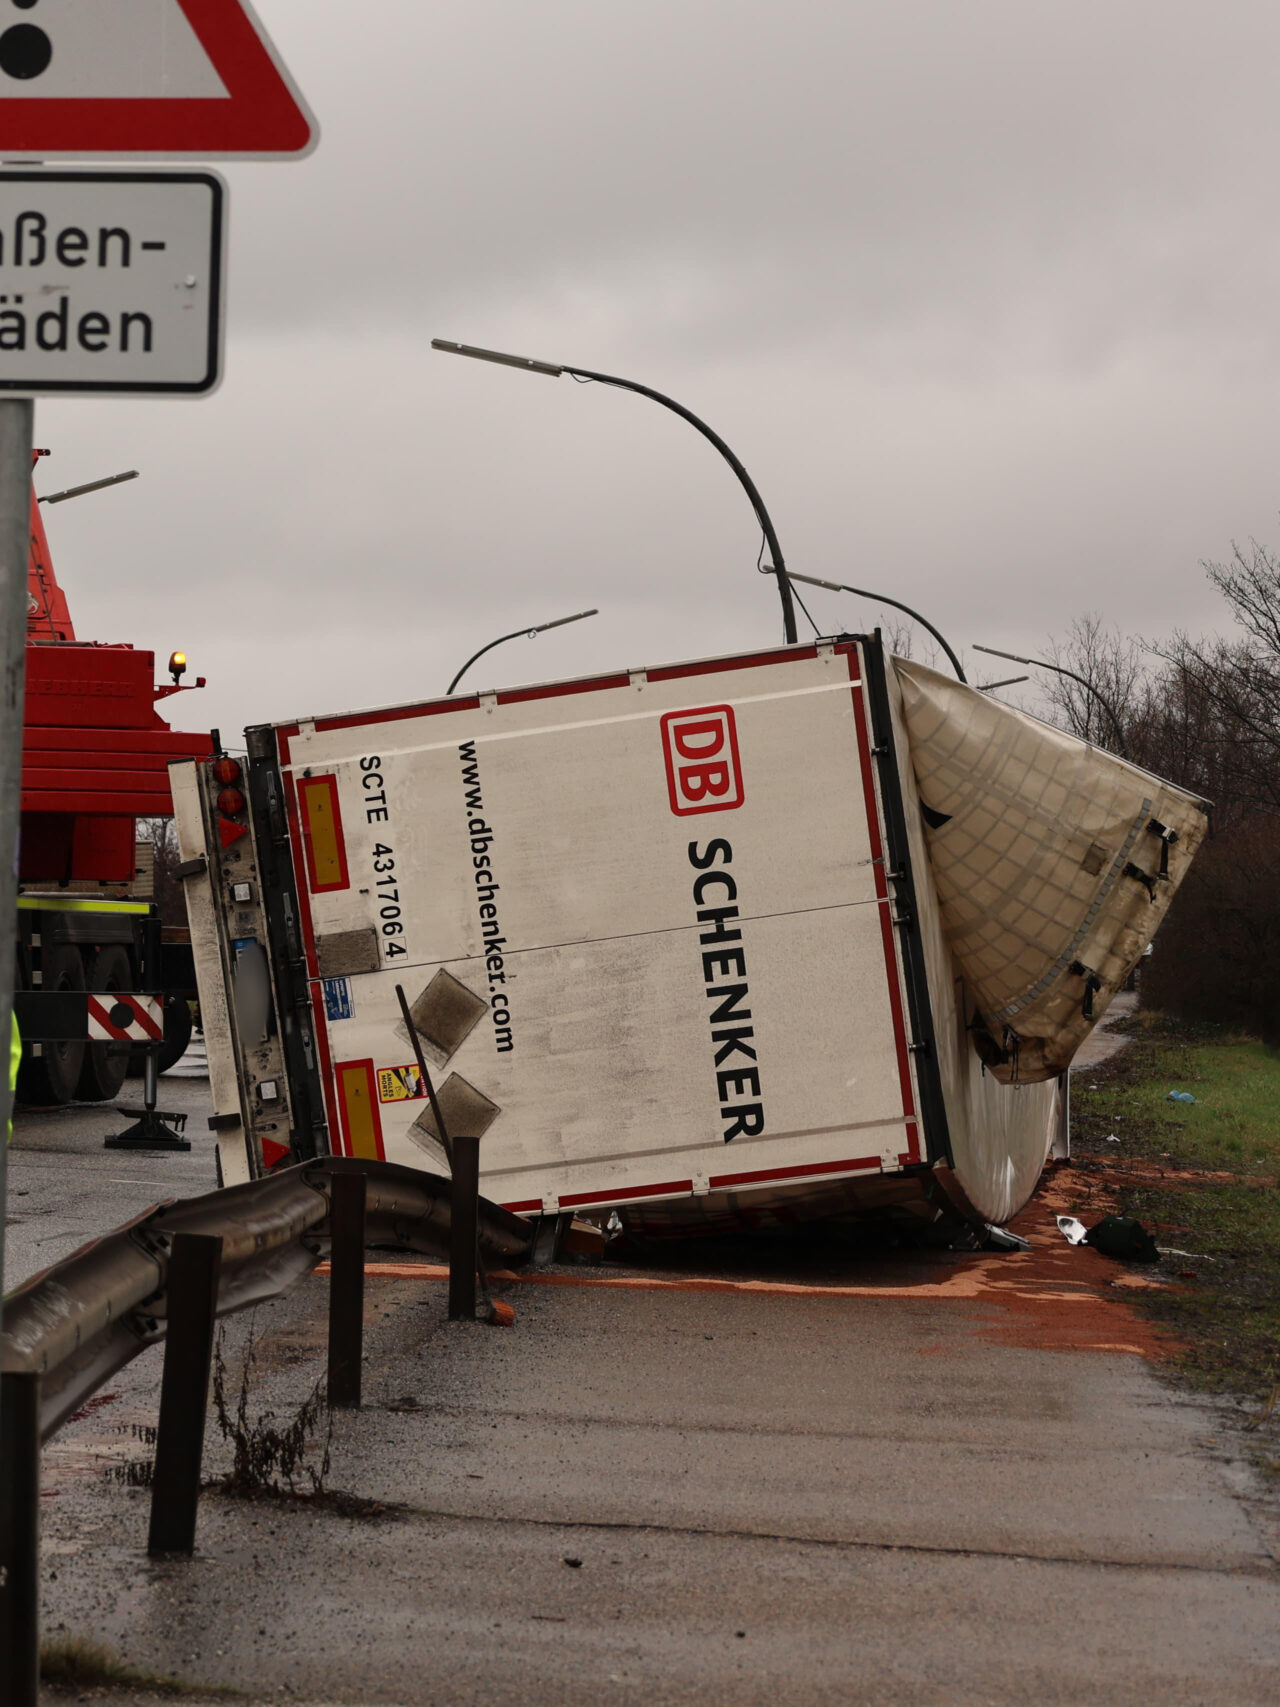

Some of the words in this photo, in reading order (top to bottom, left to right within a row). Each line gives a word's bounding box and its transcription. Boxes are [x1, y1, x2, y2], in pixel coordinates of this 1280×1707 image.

[360, 755, 389, 824] SCTE
[673, 718, 730, 802] DB
[372, 842, 404, 936] 431706
[458, 740, 515, 1053] www.dbschenker.com
[687, 838, 765, 1144] SCHENKER
